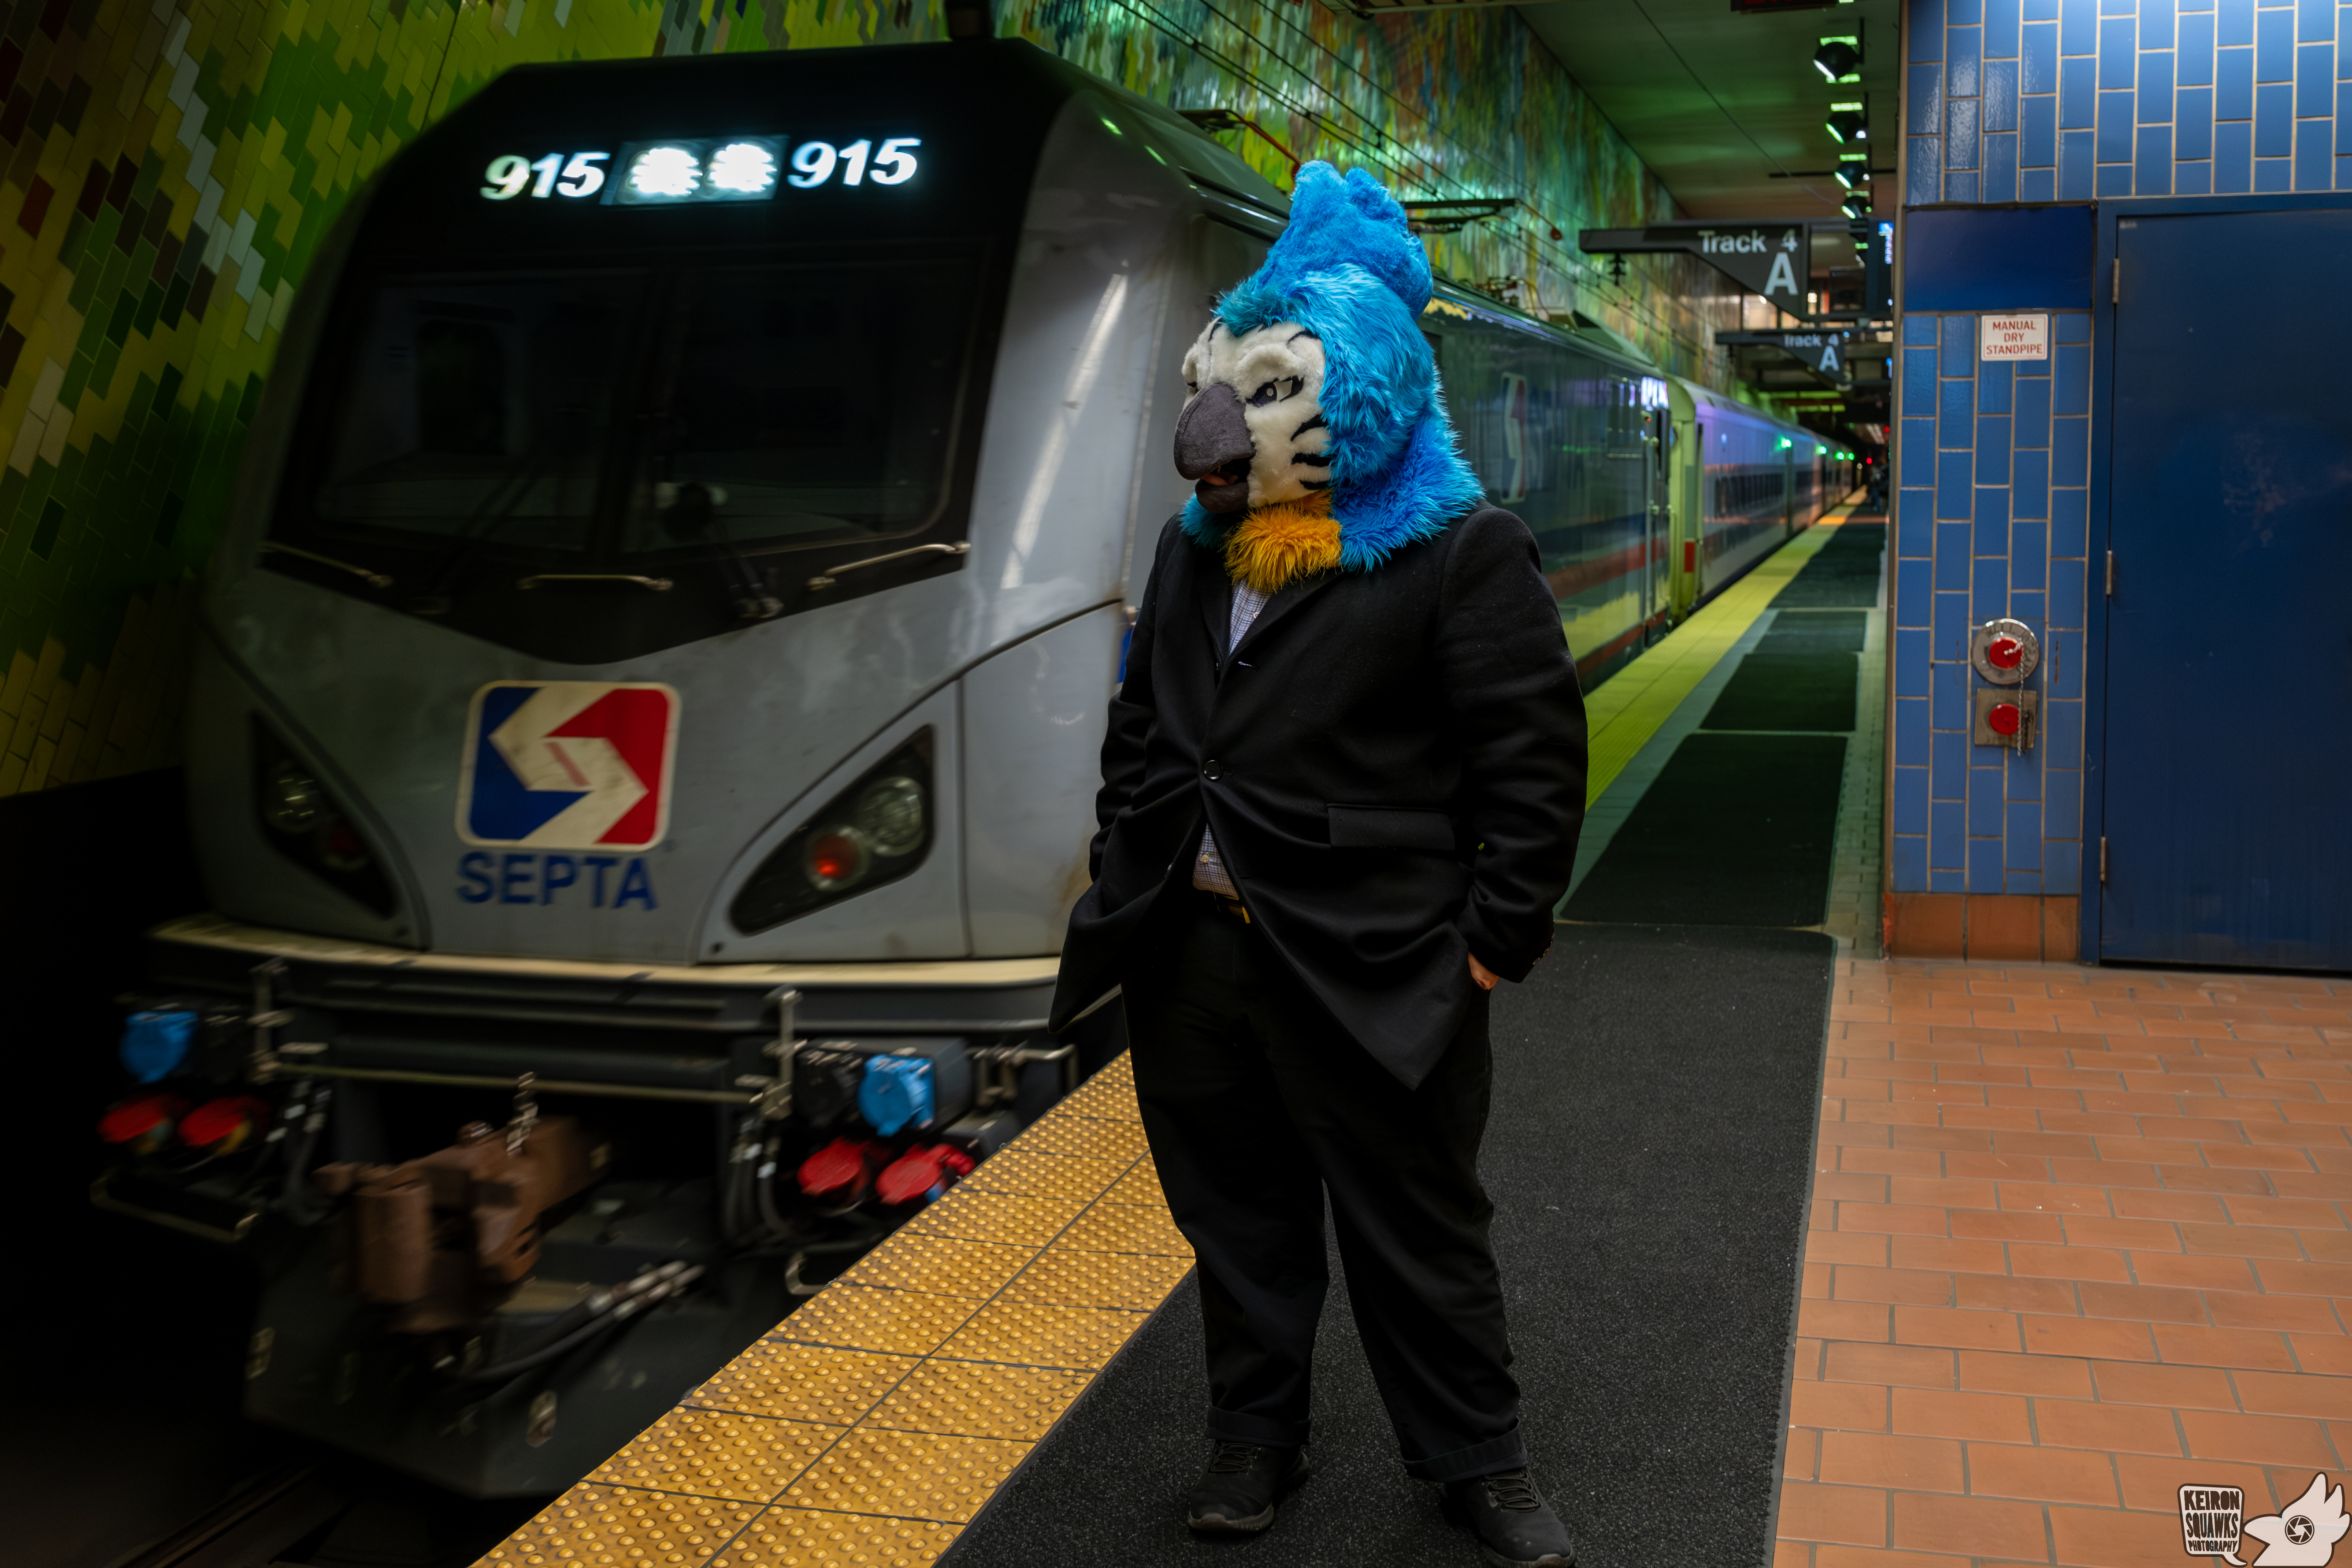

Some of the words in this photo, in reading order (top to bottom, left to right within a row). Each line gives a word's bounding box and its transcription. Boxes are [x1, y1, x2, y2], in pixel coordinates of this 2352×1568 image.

[481, 152, 610, 200] 915
[788, 138, 921, 188] 915
[1698, 229, 1767, 253] Track
[1781, 229, 1798, 252] 4
[1764, 252, 1799, 296] A
[1993, 320, 2037, 331] MANUAL
[2004, 332, 2024, 342] DRY
[1828, 333, 1839, 347] 4
[1986, 344, 2043, 355] STANDPIPE
[1818, 345, 1840, 371] A
[456, 851, 657, 911] SEPTA
